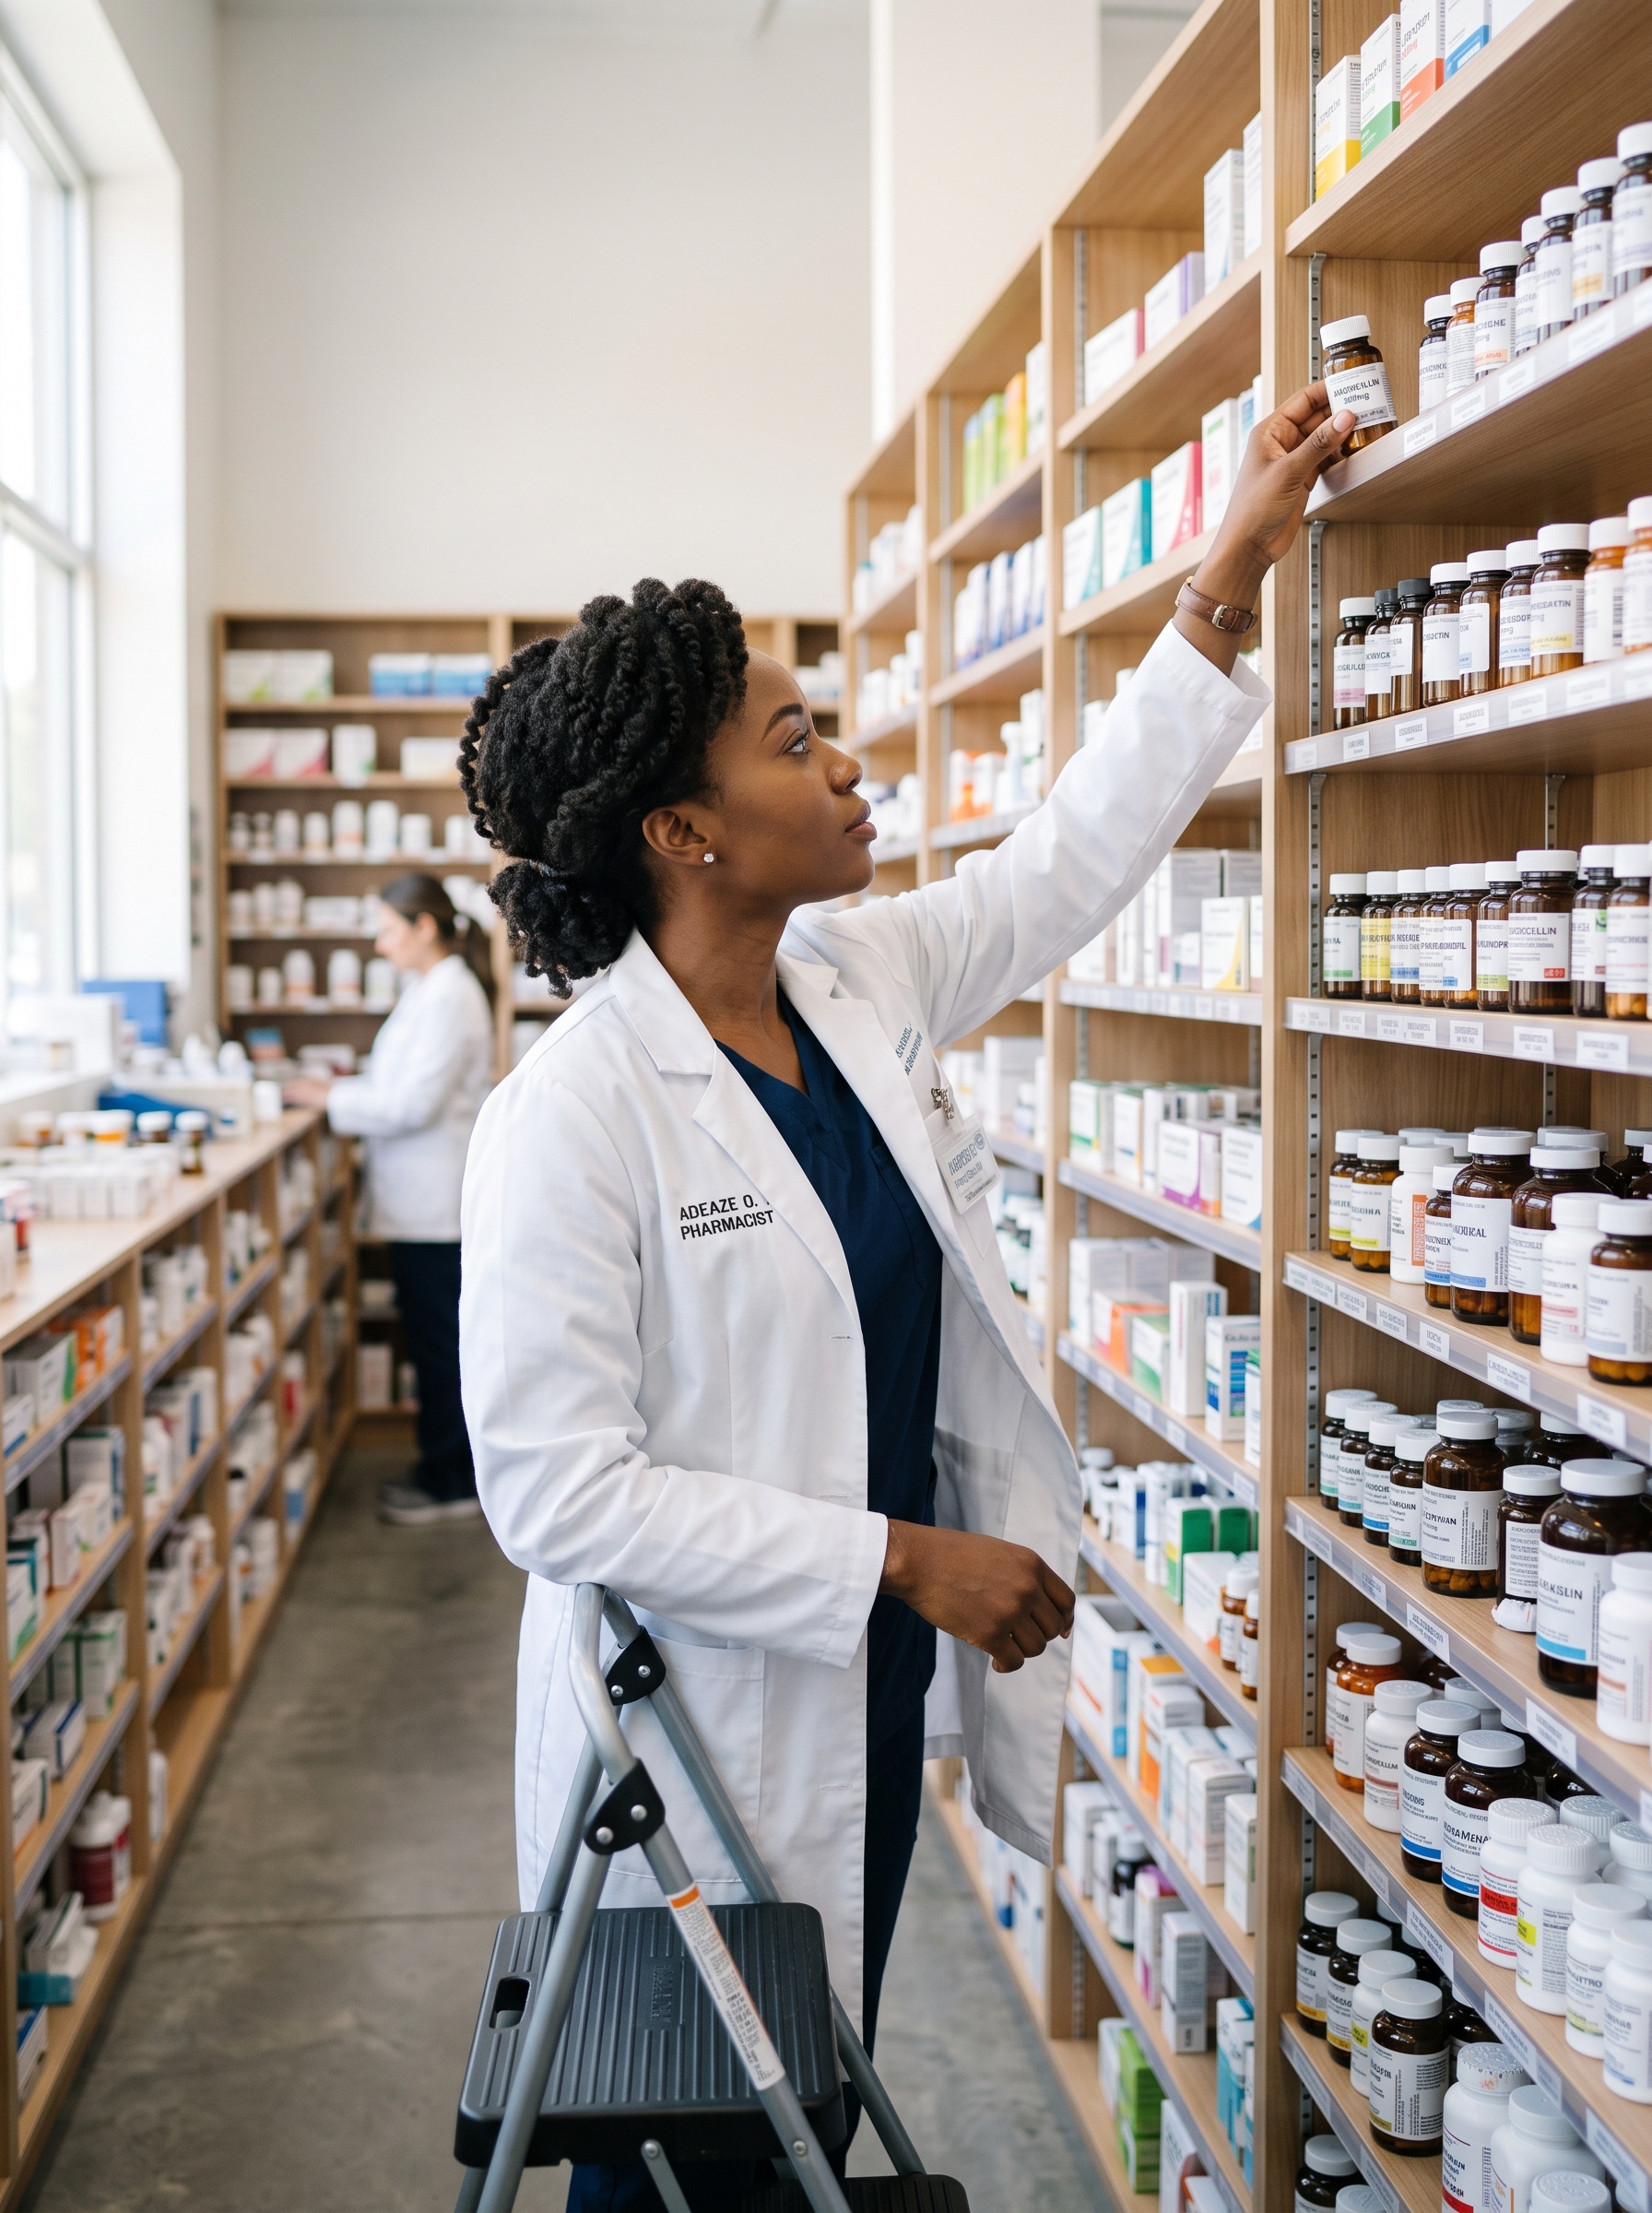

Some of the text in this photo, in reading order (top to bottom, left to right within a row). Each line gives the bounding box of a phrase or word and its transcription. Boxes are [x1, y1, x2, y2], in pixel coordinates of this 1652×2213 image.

[680, 1194, 758, 1221] ADEAZE O.
[680, 1210, 773, 1240] PHARMACIST
